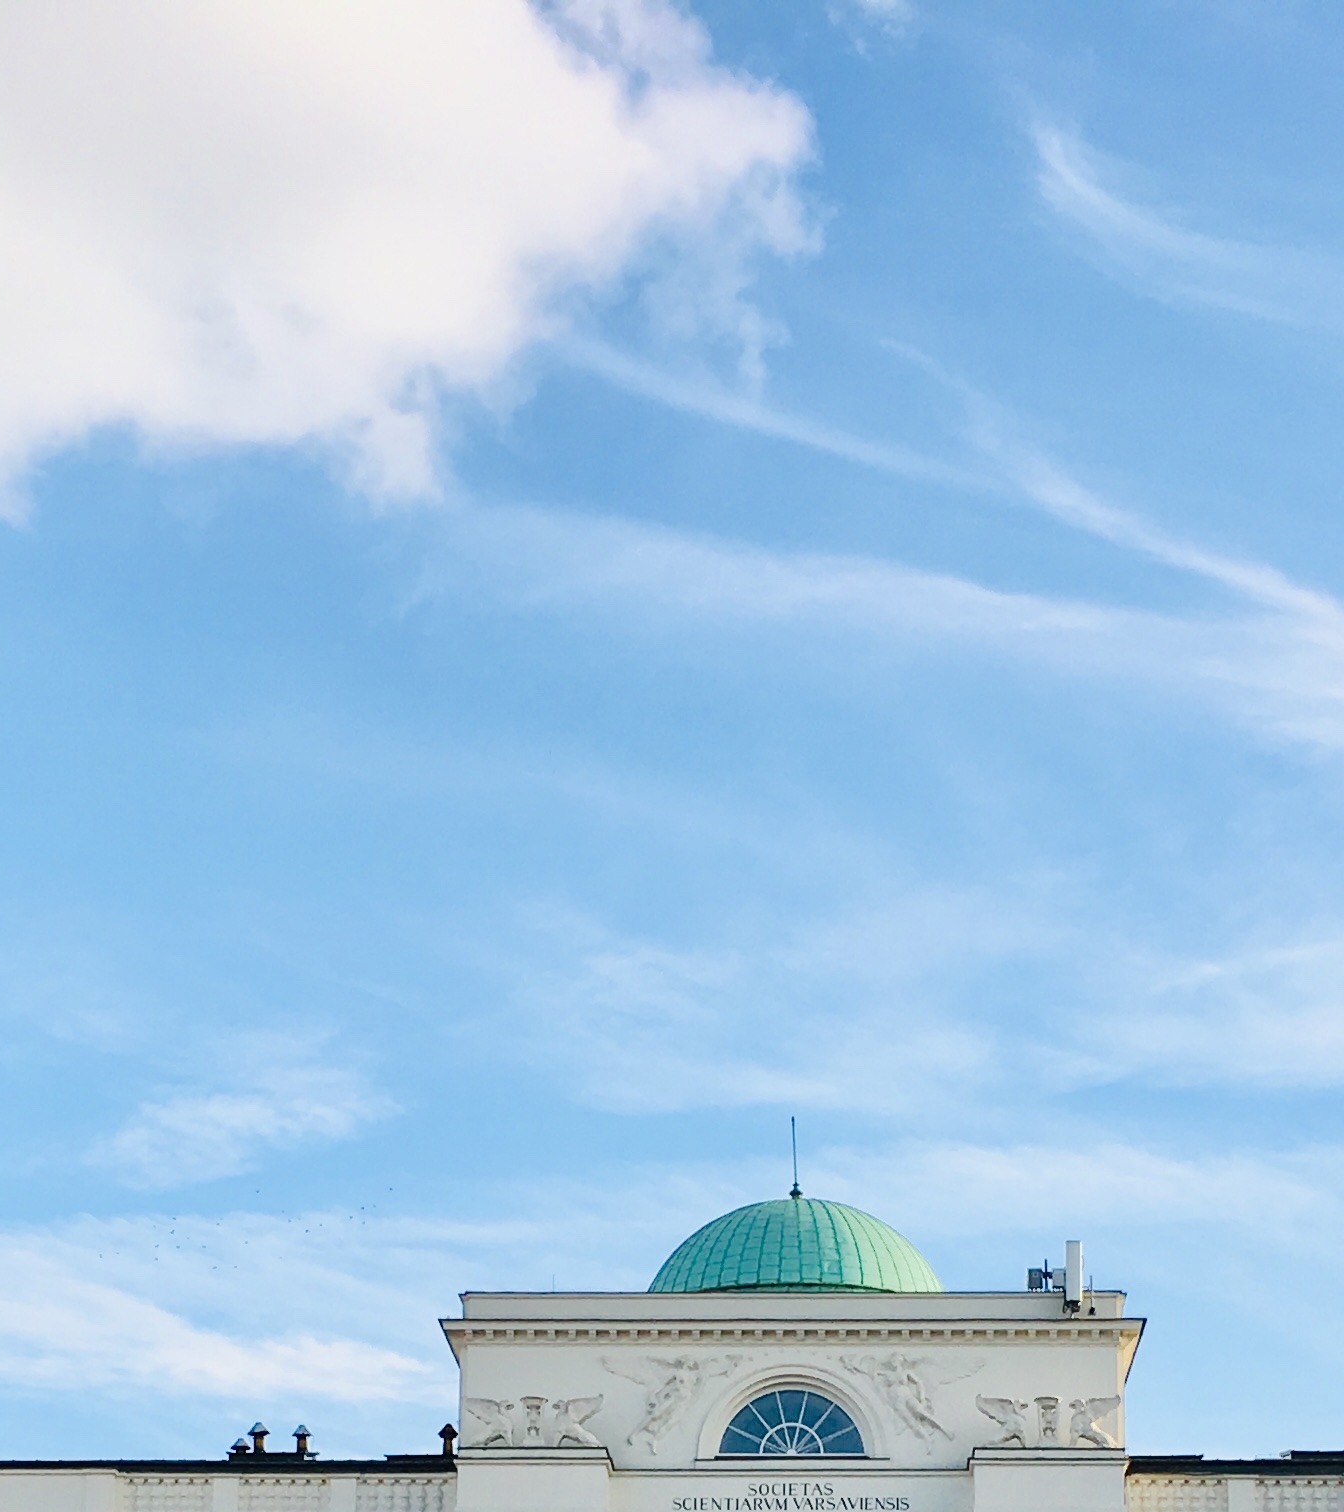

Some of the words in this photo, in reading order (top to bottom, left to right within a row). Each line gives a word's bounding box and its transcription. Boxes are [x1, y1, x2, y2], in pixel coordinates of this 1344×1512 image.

[747, 1482, 834, 1497] SOCIETAS
[672, 1497, 788, 1511] SCIENTIARVM
[792, 1496, 910, 1511] VARSAVIENSIS
